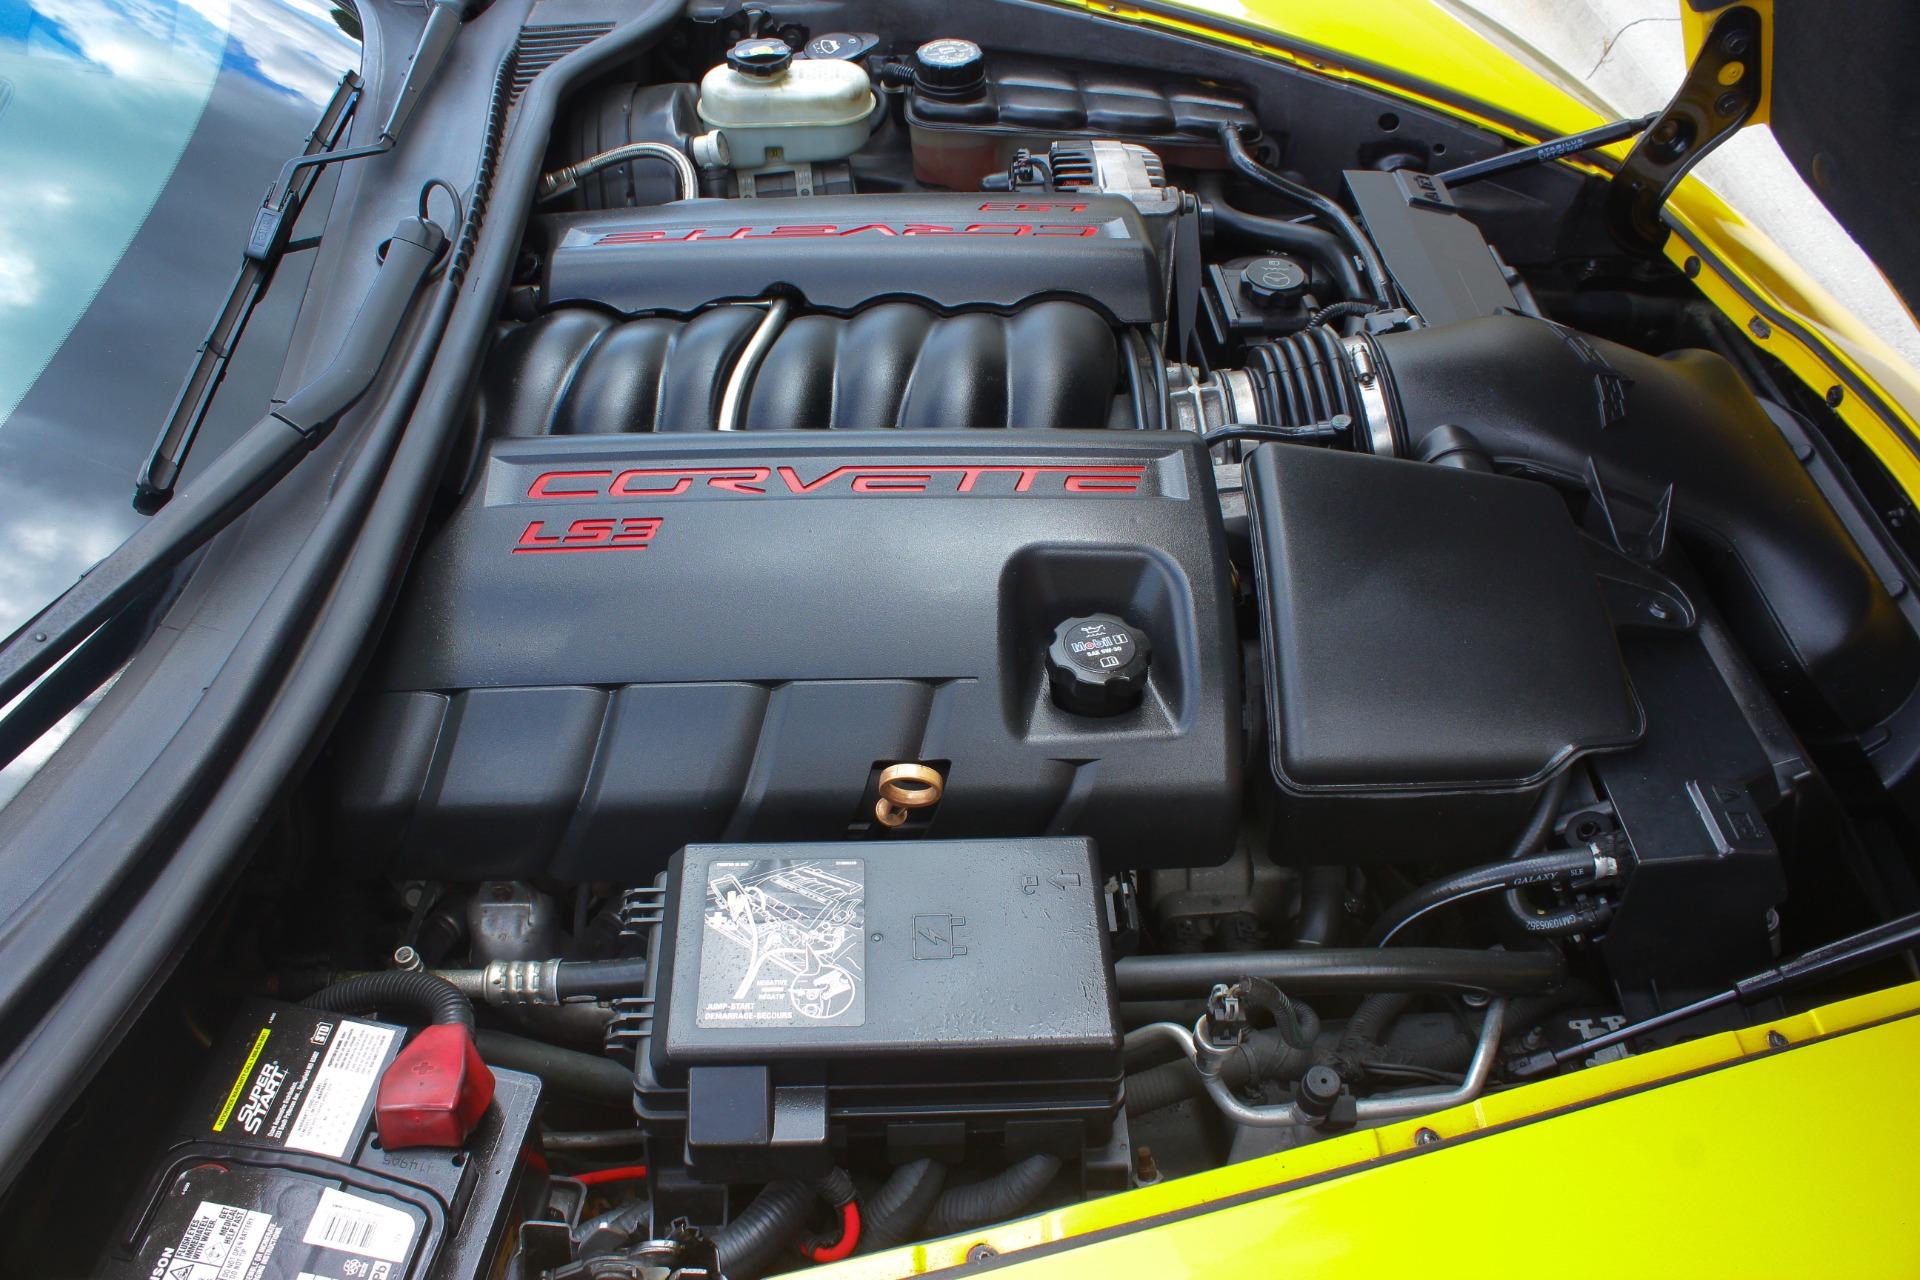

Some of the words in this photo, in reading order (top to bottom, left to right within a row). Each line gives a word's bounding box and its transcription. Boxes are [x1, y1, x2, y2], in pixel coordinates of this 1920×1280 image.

[593, 224, 1098, 246] CORVETTE
[527, 465, 1146, 497] CORVETTE
[518, 517, 665, 546] LS3
[1071, 636, 1113, 653] Mobil
[1513, 871, 1558, 886] GALAXY
[705, 1002, 755, 1010] JUMP-START
[315, 1025, 329, 1043] STD
[237, 1063, 275, 1122] SUPER
[244, 1066, 284, 1135] START
[219, 1207, 230, 1219] GET
[219, 1209, 238, 1236] MEDICAL
[176, 1237, 192, 1257] FLUSH
[187, 1219, 200, 1236] EYES
[184, 1216, 210, 1258] IMMEDIATELY
[192, 1242, 206, 1260] WITH
[201, 1219, 217, 1242] WATER.
[223, 1228, 235, 1245] HELP
